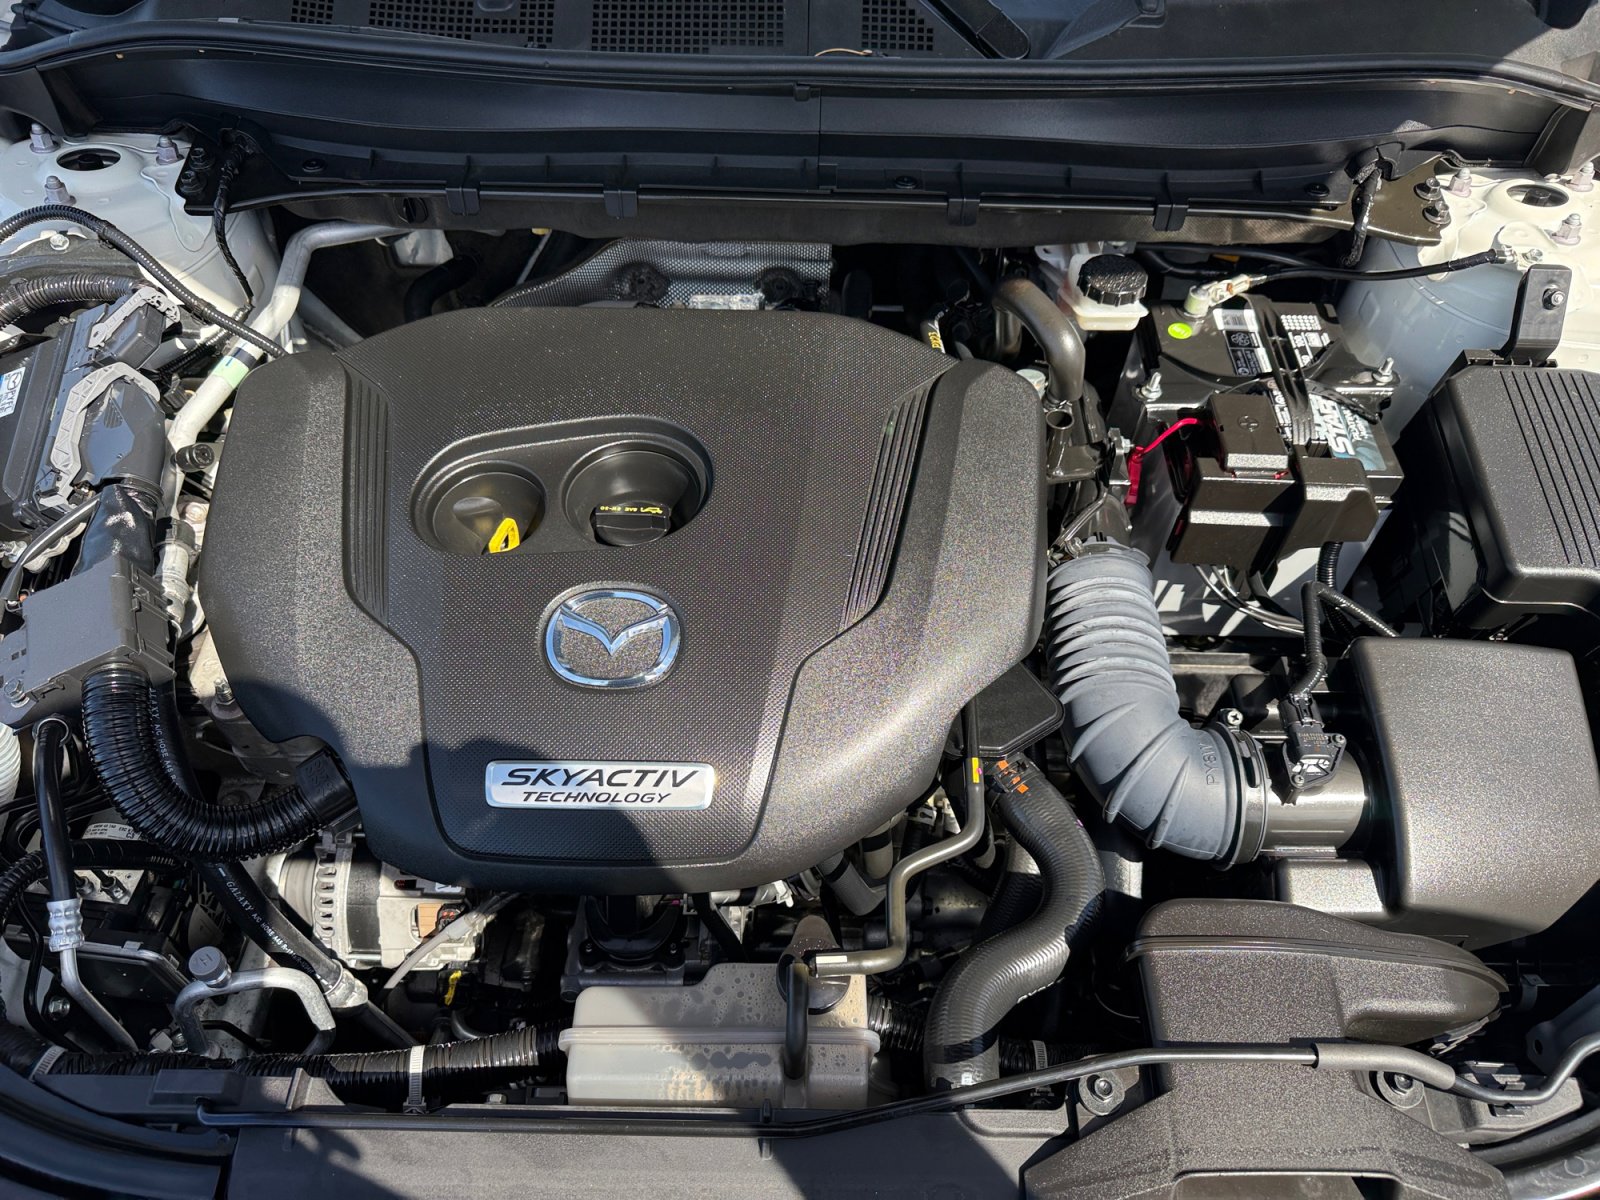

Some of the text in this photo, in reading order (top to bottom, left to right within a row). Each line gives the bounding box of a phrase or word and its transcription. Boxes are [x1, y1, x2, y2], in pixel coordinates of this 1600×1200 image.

[158, 739, 169, 758] HOSE
[501, 768, 699, 788] SKYACTIV
[522, 791, 672, 804] TECHNOLOGY
[226, 880, 255, 912] GALAXY
[251, 913, 262, 924] A/C
[260, 922, 275, 938] HOSE
